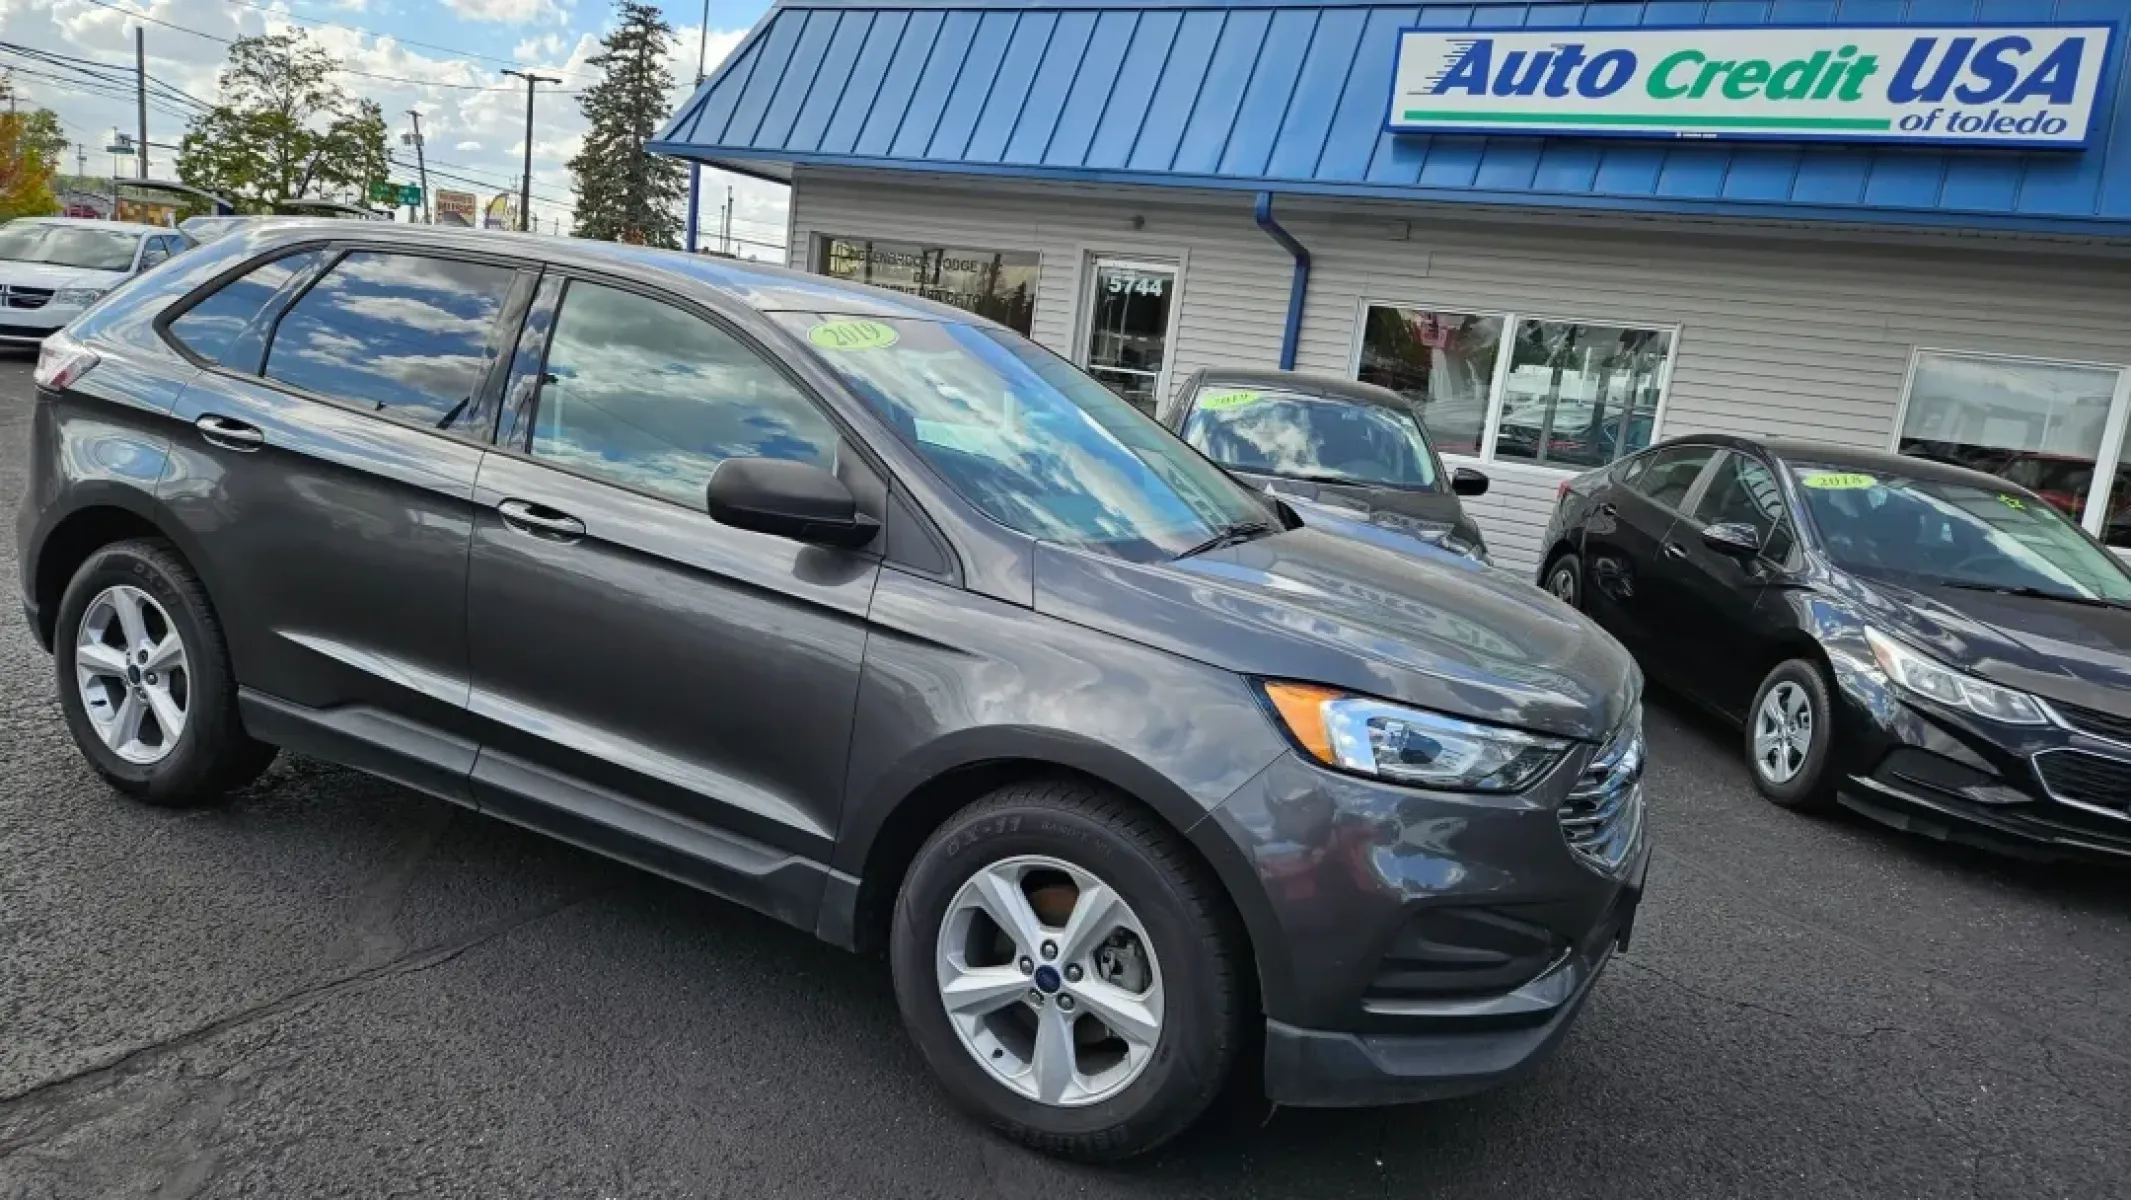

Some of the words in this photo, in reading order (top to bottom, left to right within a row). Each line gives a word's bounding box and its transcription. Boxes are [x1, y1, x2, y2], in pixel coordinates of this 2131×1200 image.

[1422, 37, 1638, 98] Auto
[1646, 44, 1879, 101] Credit
[1886, 35, 2086, 105] USA
[1898, 107, 1944, 131] of
[1945, 108, 2068, 135] toledo
[1109, 275, 1163, 297] 5744
[822, 322, 881, 347] 2019
